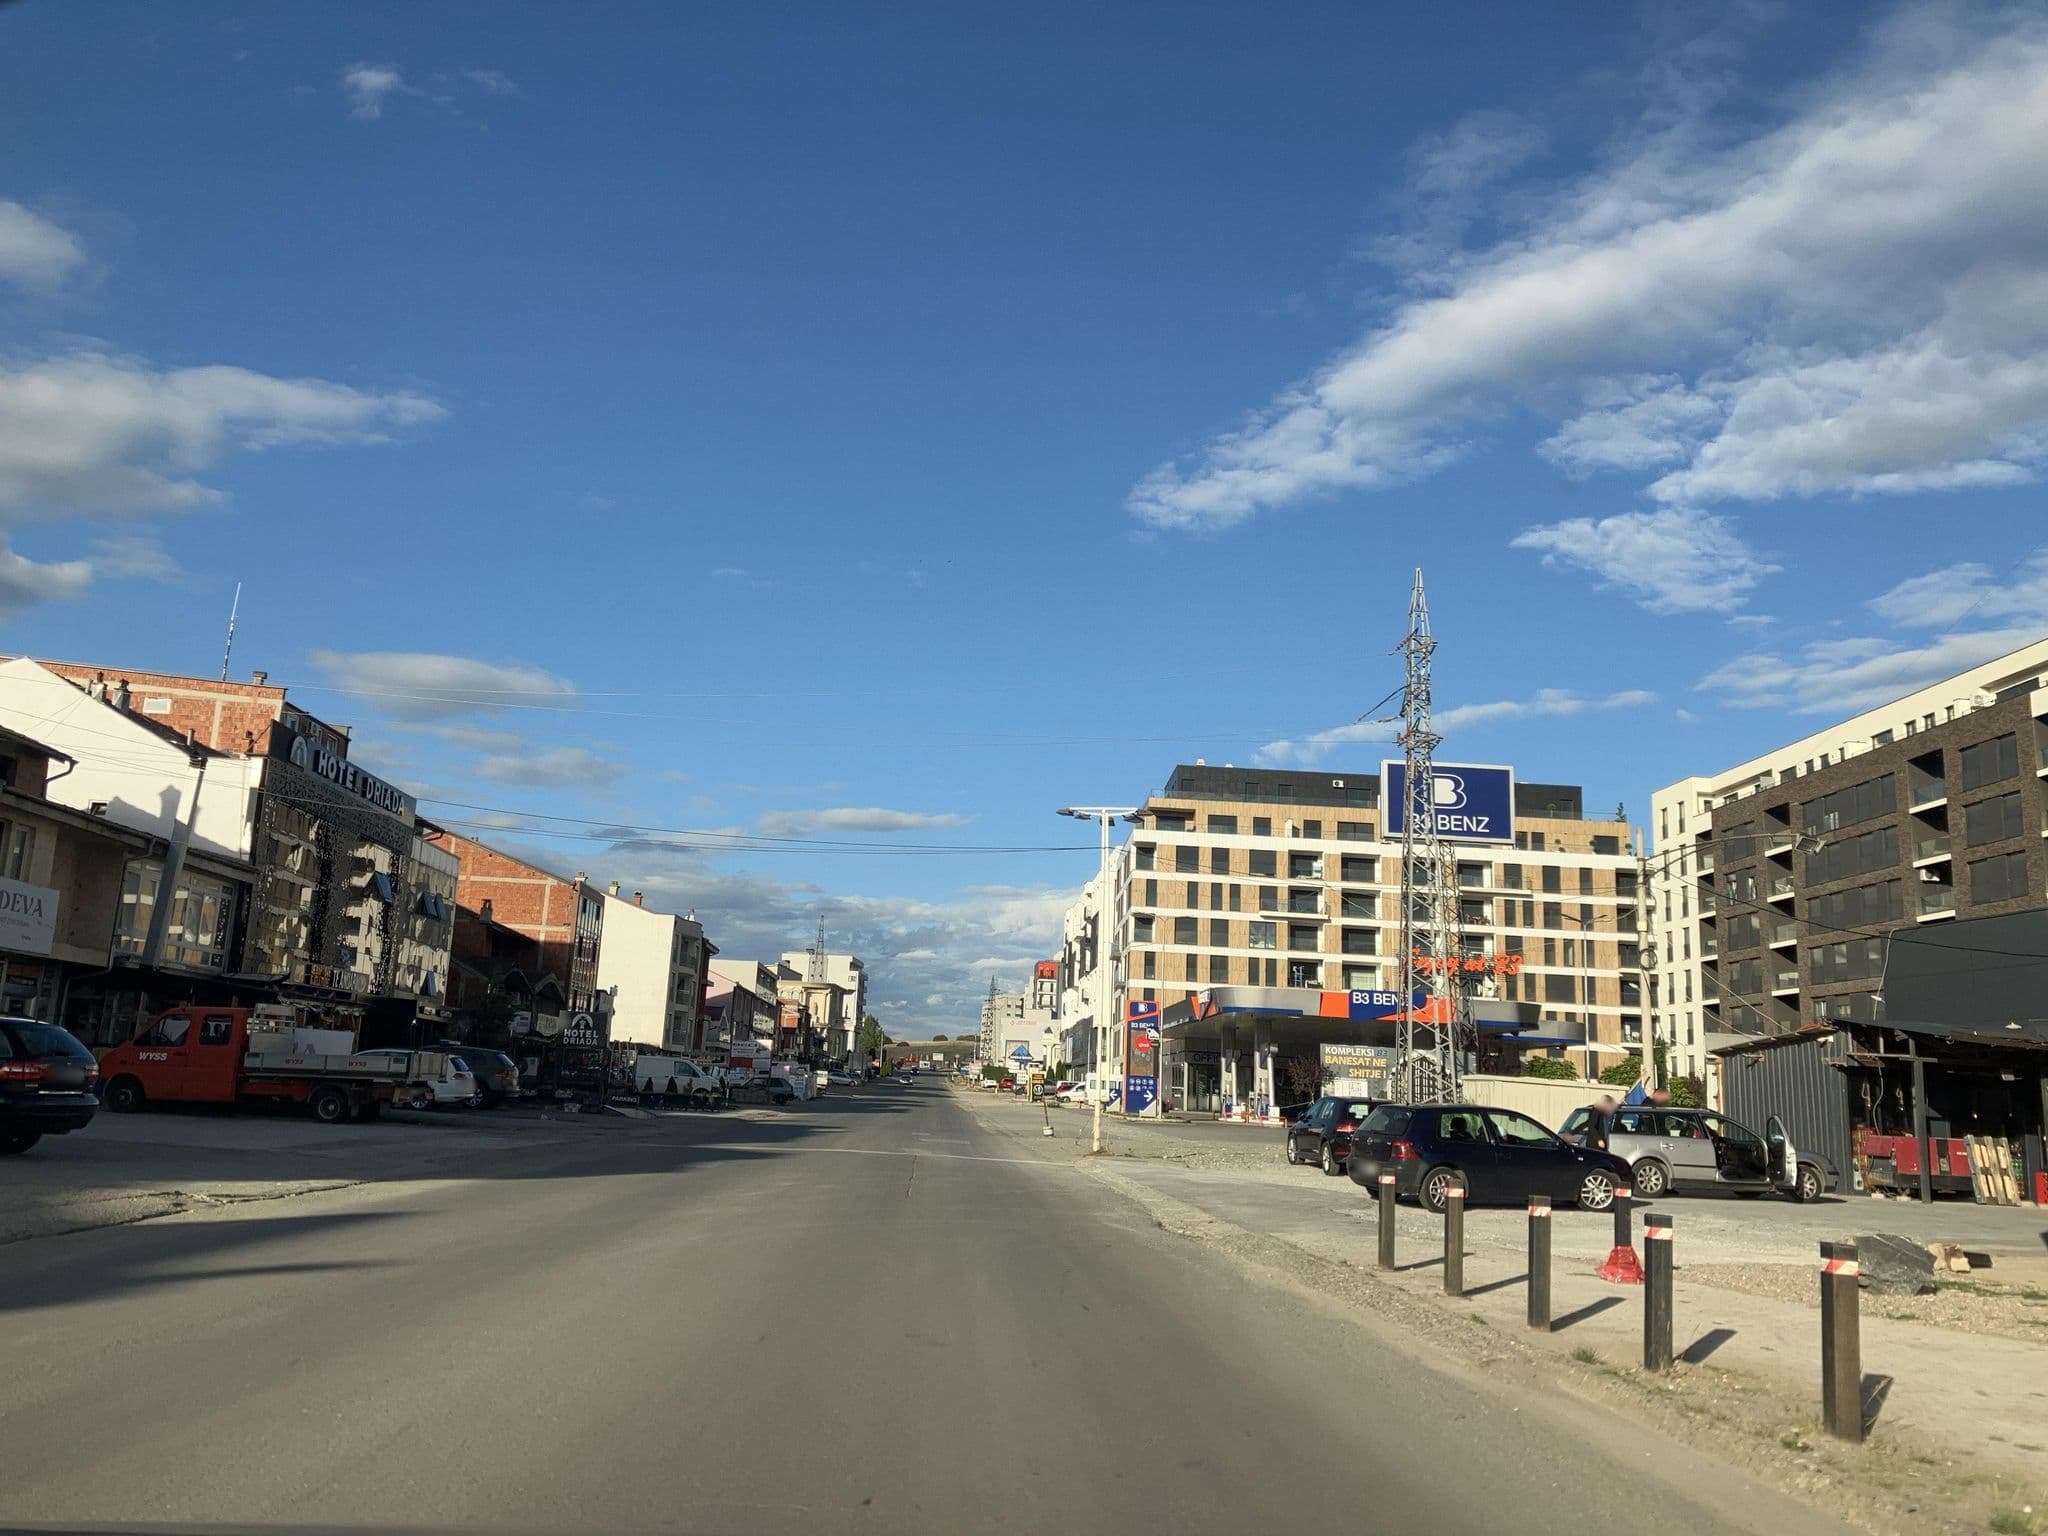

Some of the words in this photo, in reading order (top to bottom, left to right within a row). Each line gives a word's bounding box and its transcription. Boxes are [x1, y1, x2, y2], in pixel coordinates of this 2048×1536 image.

[317, 750, 358, 793] HOTEL
[365, 777, 405, 817] DRIADA
[1437, 815, 1490, 833] BENZ
[0, 889, 43, 918] DEVA
[1493, 953, 1523, 976] B3
[1352, 992, 1370, 1005] B3
[1373, 993, 1409, 1006] BEN
[563, 1028, 599, 1039] HOTEL
[562, 1036, 598, 1046] DRIADA
[139, 1051, 168, 1061] WYSS
[1325, 1046, 1375, 1057] KOMPLEKSI
[1324, 1055, 1371, 1067] BANESAT
[1372, 1058, 1387, 1068] NE
[1348, 1068, 1382, 1078] SHITJE
